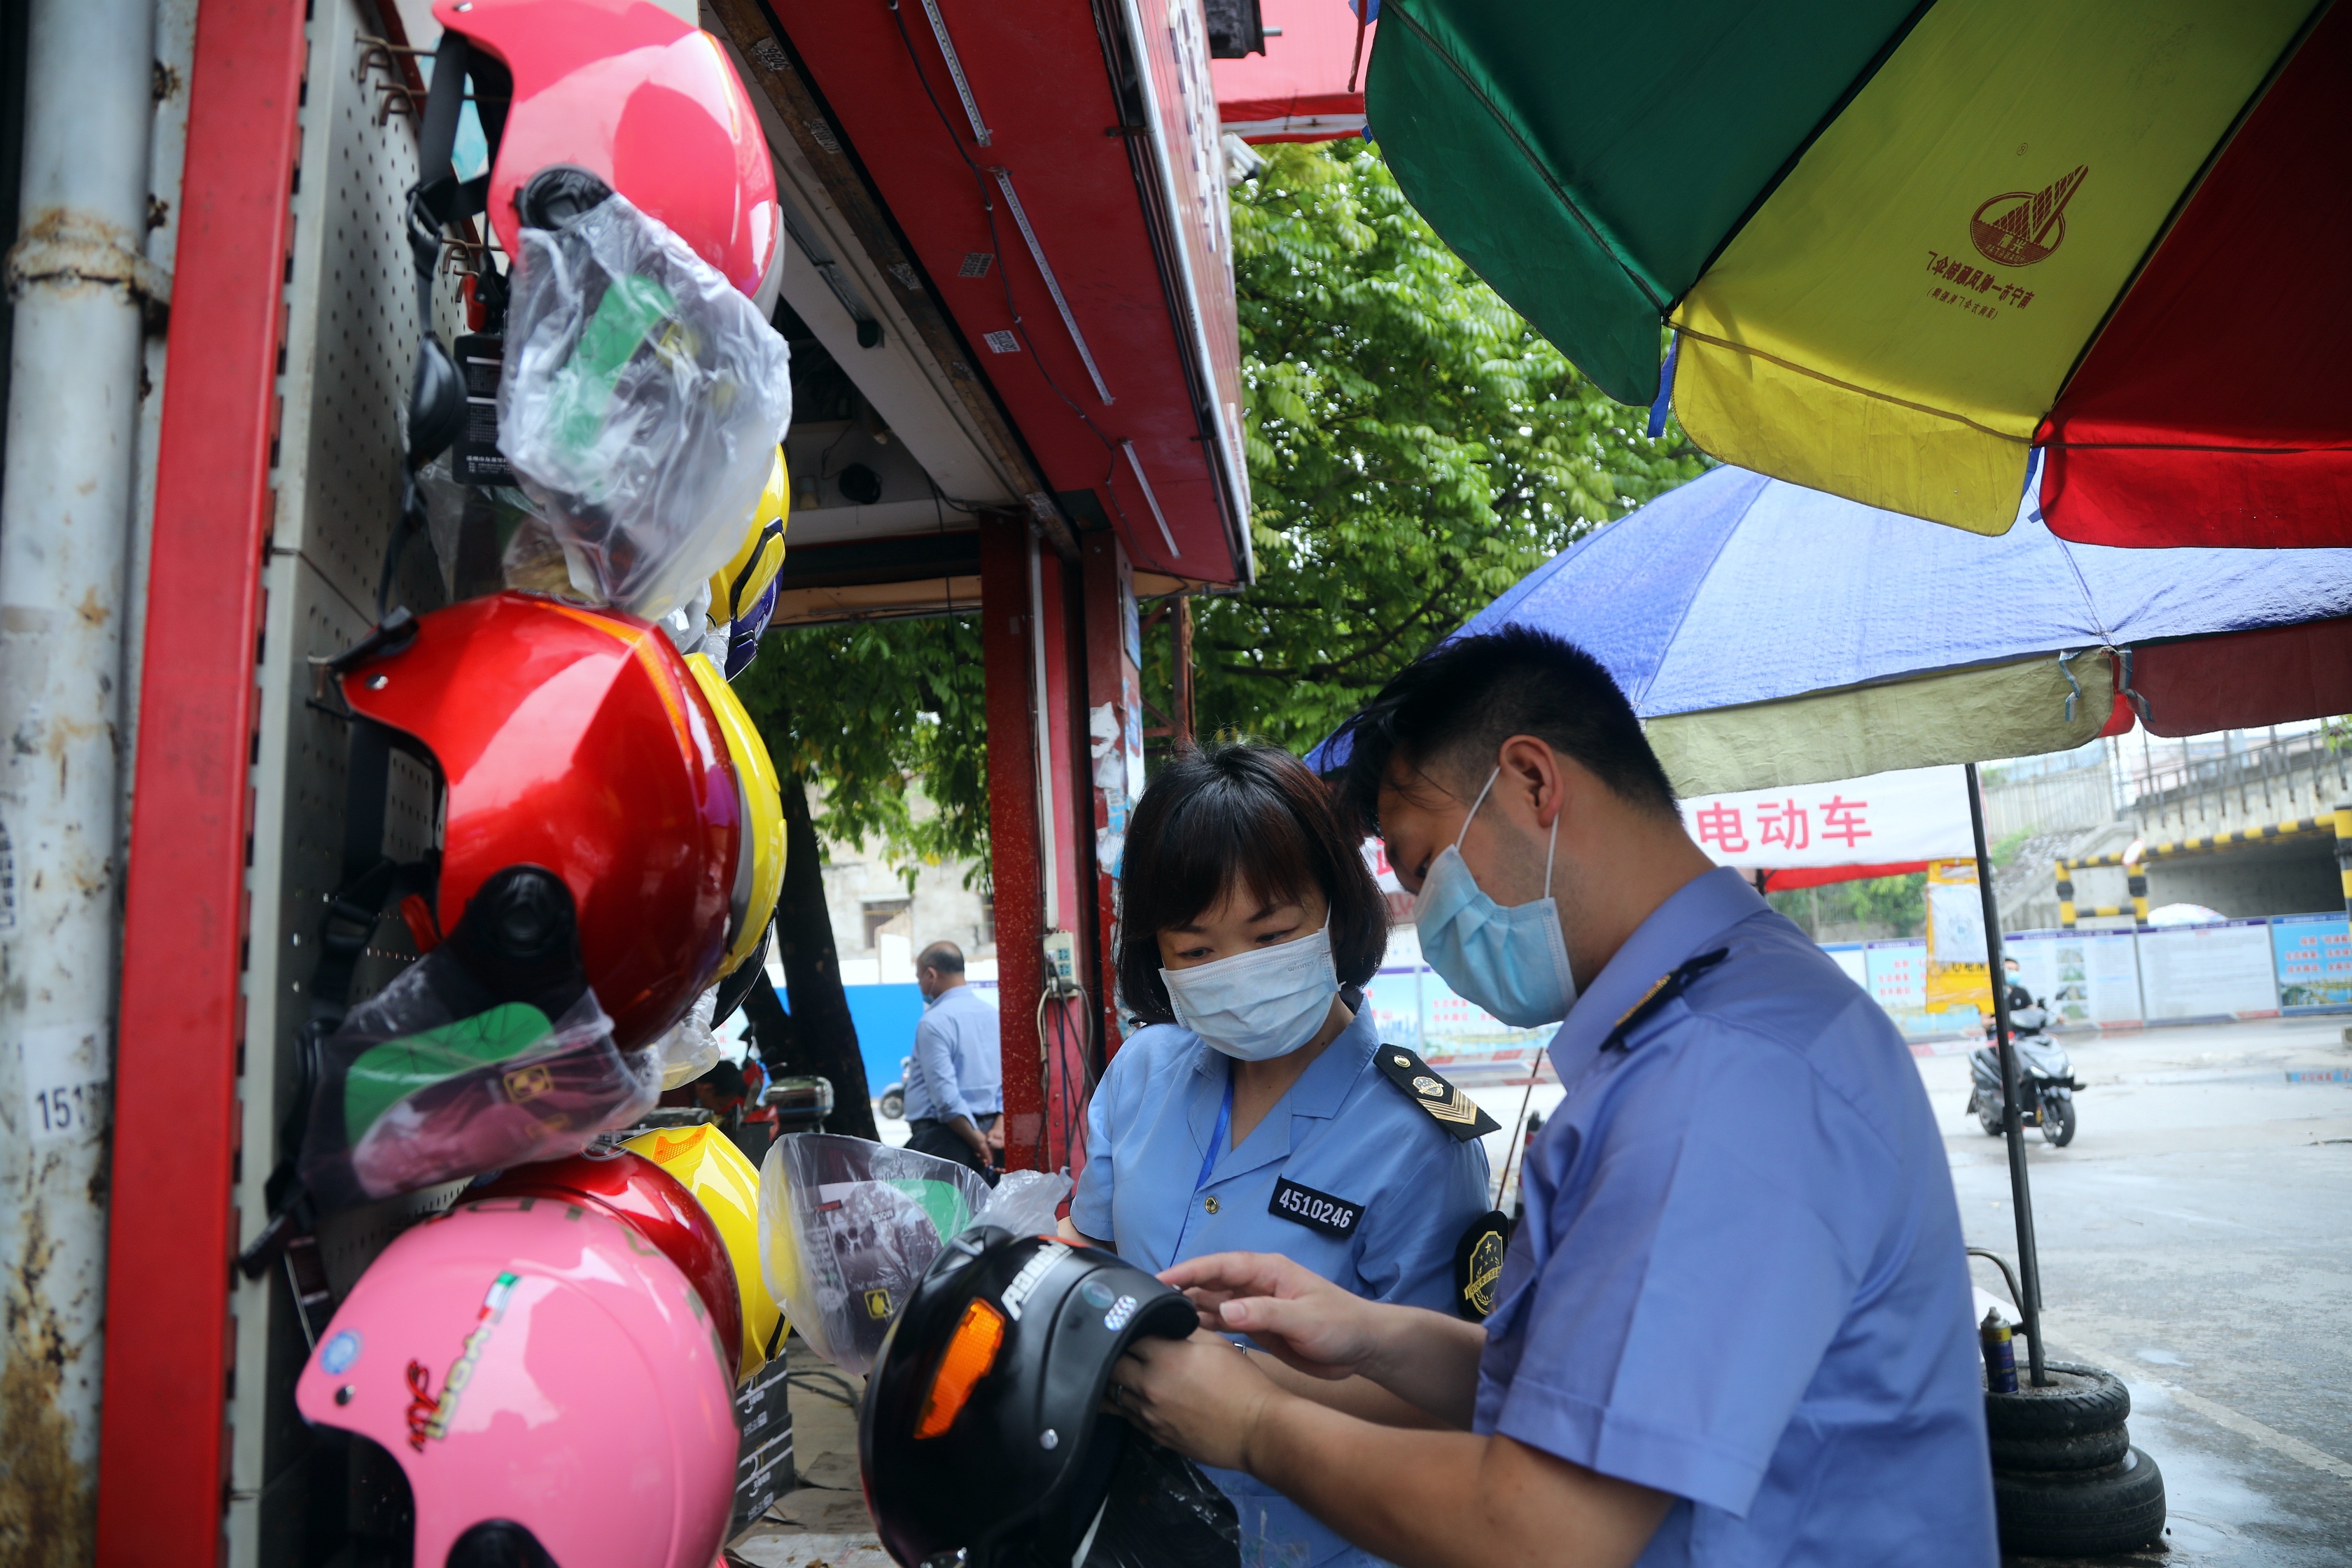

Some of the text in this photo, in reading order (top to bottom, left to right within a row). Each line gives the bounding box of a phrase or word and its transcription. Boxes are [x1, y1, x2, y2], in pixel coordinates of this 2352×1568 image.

[1696, 794, 1873, 853] 电动车
[1279, 1188, 1353, 1228] 4510246
